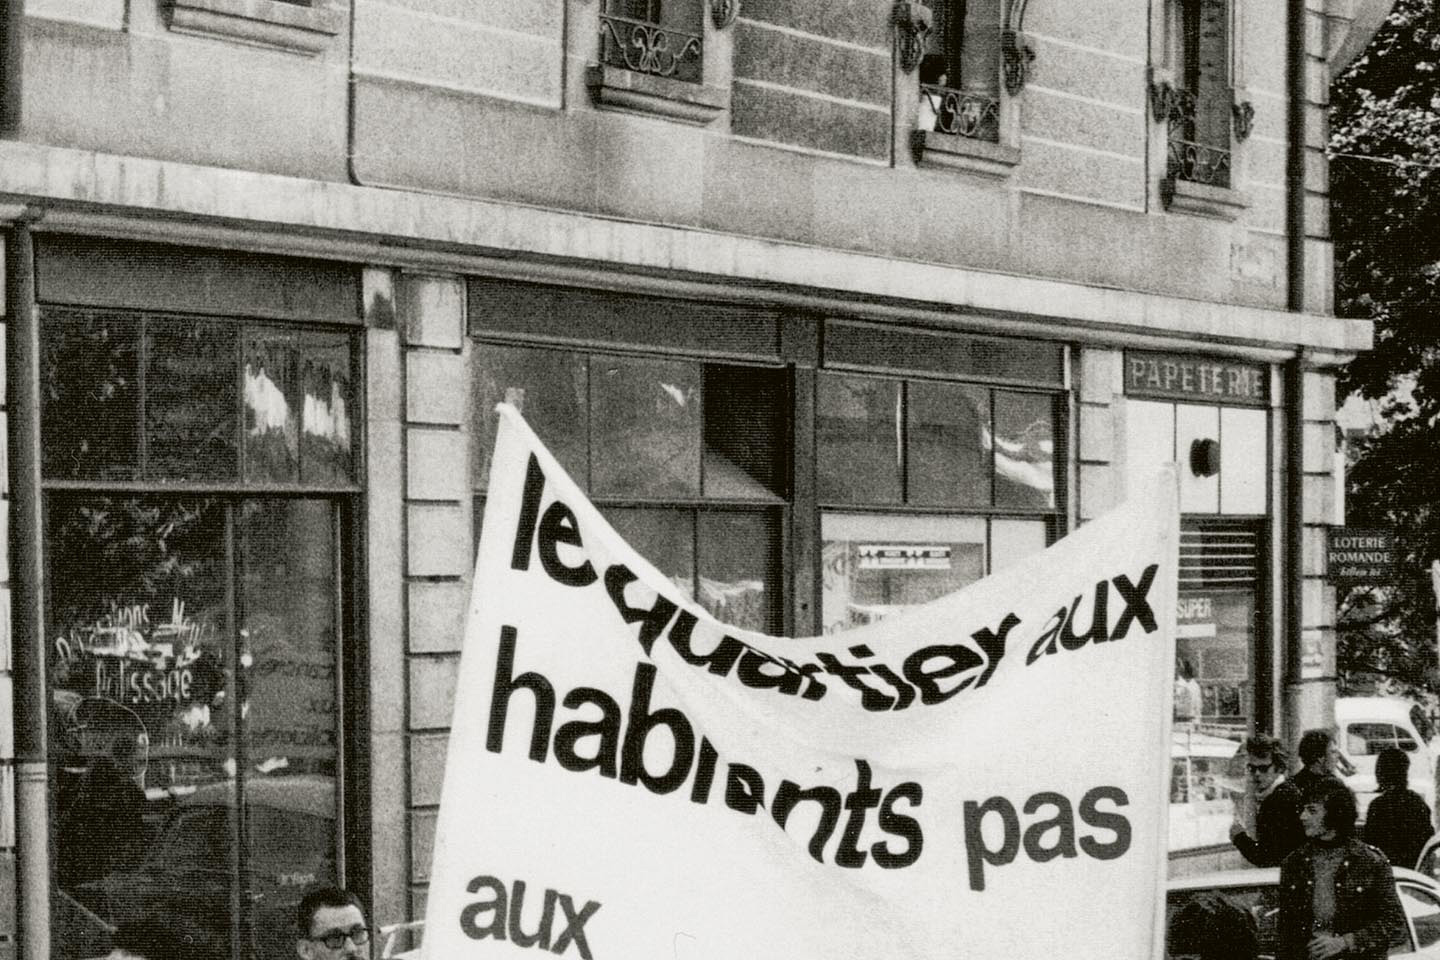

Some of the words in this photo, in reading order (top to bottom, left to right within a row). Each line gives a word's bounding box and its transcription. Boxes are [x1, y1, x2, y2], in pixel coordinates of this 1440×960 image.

[1130, 358, 1264, 397] PAPETERIE
[511, 451, 599, 587] le
[1025, 563, 1159, 667] aux
[1329, 551, 1391, 563] ROMANDE
[1334, 536, 1386, 548] LOTERIE
[963, 785, 1132, 892] pas
